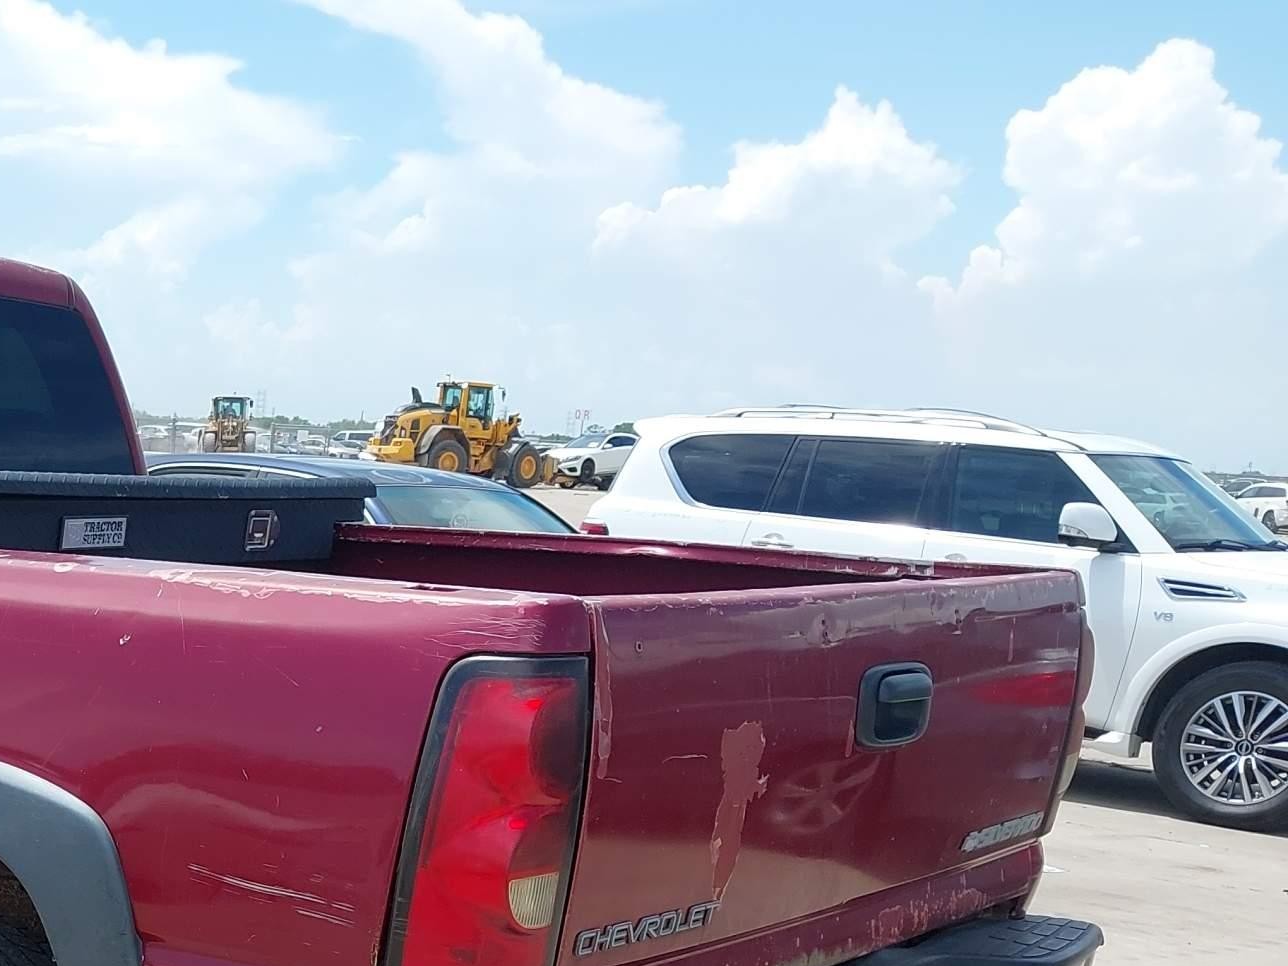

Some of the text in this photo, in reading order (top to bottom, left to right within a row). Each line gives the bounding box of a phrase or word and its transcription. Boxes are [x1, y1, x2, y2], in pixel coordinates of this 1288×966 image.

[83, 521, 123, 533] TRACTOR
[81, 533, 112, 544] SUPPLY
[1153, 611, 1174, 621] V8
[574, 900, 720, 957] CHEVROLET
